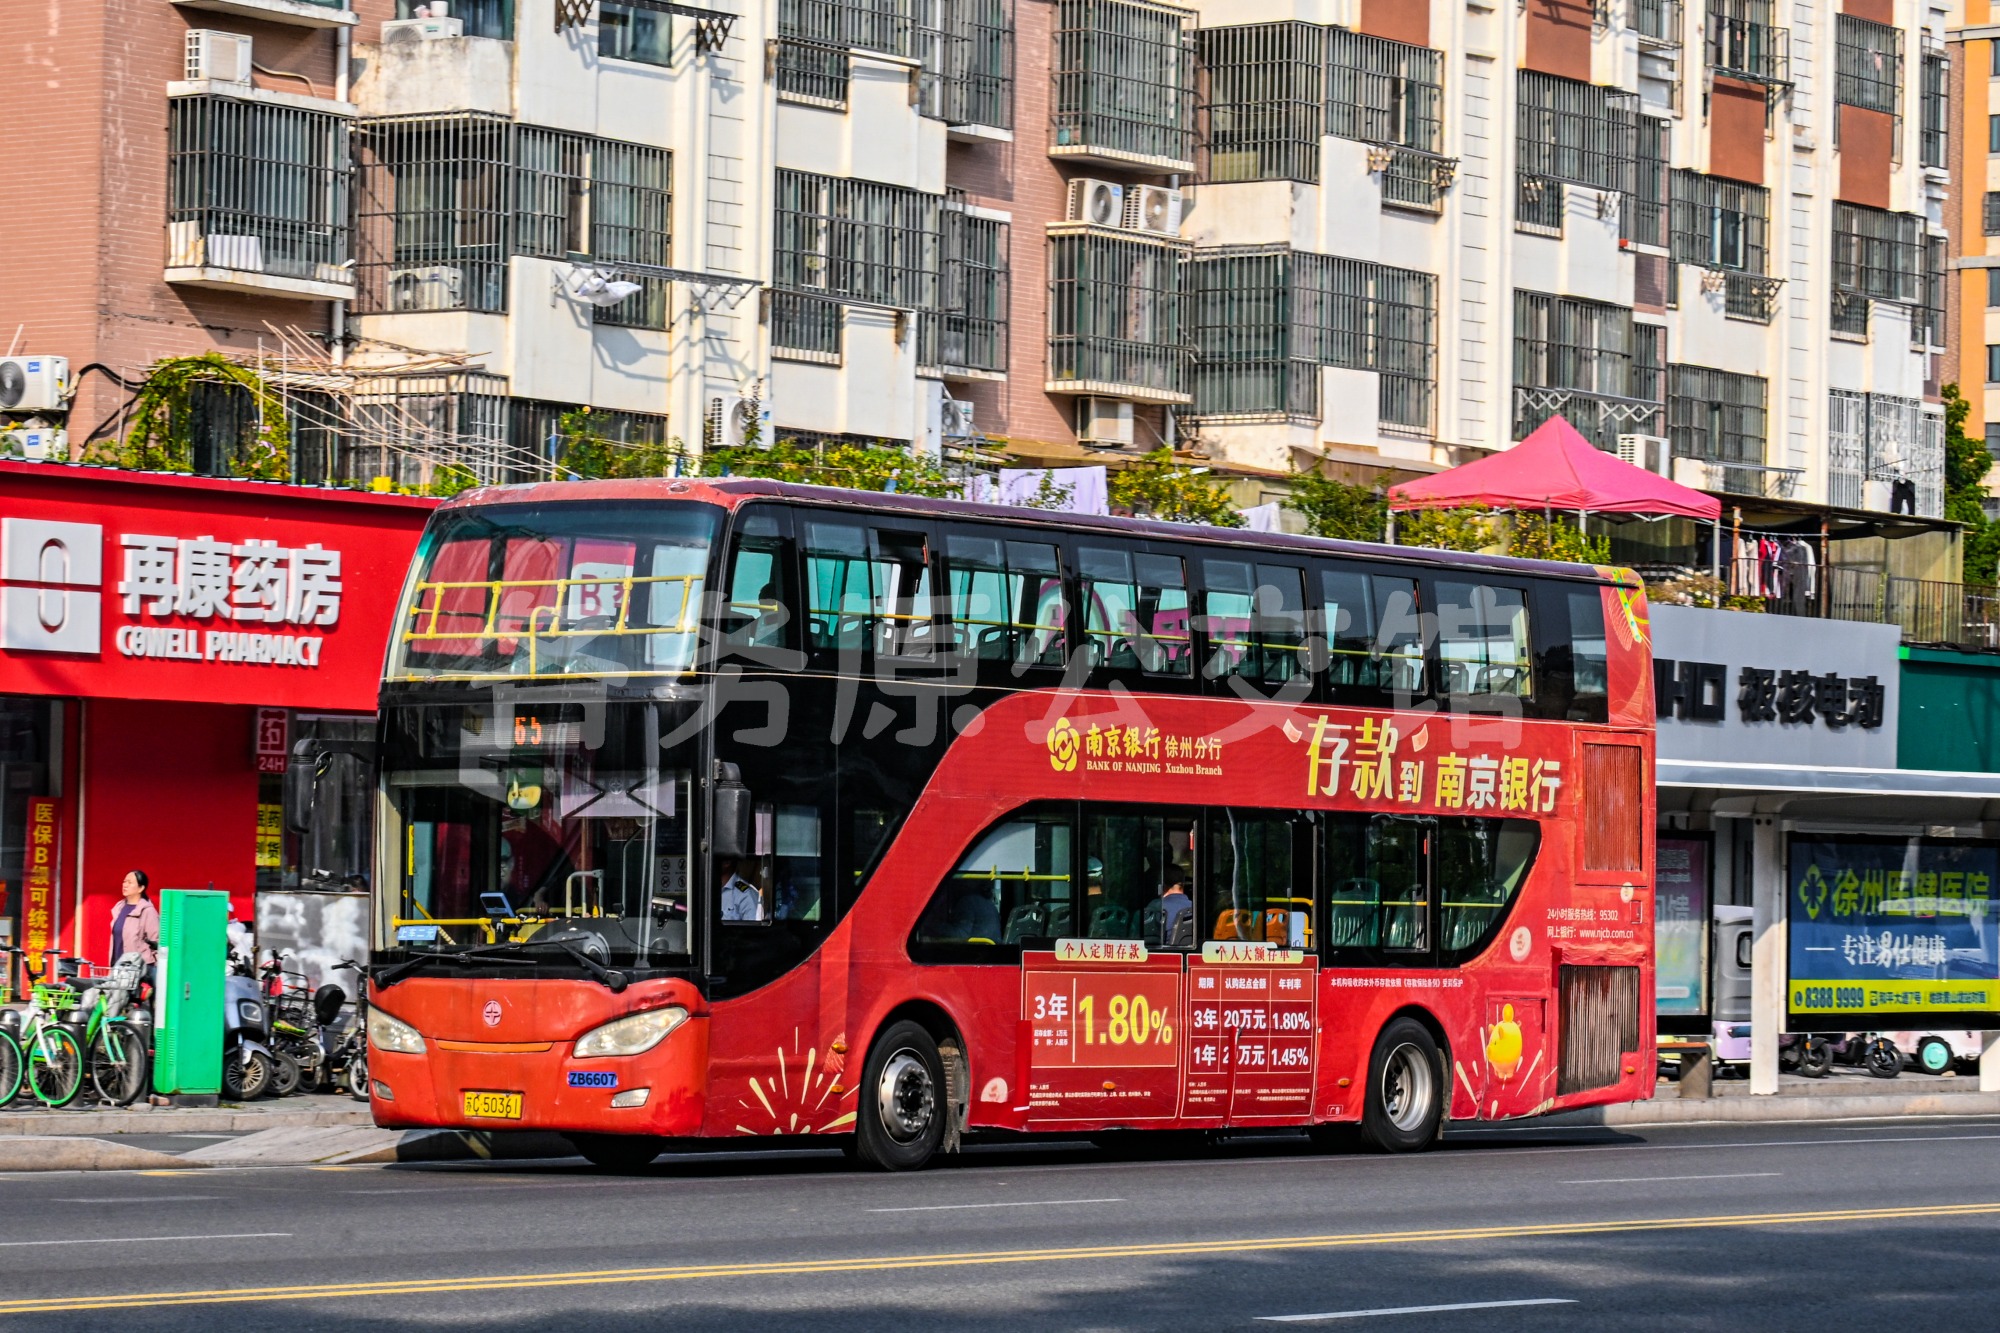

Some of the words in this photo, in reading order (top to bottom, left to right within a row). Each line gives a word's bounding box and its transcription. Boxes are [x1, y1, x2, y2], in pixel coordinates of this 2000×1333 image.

[117, 533, 343, 626] 再康药房
[116, 625, 203, 660] COWELL
[205, 630, 323, 667] PHARMACY
[1737, 666, 1885, 729] 极核电动
[1085, 722, 1162, 760] 南京银行
[1165, 735, 1223, 761] 徐州分行
[258, 755, 285, 772] 24H
[1086, 760, 1110, 772] BANK
[1112, 761, 1124, 772] OF
[1125, 762, 1161, 774] NANJING
[1165, 762, 1194, 775] Xuzhou
[1195, 764, 1223, 776] Branch
[1063, 942, 1141, 960] 个人定期存款
[1198, 977, 1214, 989] 期限
[1225, 977, 1267, 990] 认购起点金额
[1278, 978, 1302, 990] 年利率
[1033, 993, 1068, 1021] 3年
[1836, 987, 1864, 1008] 9999
[1079, 994, 1173, 1045] 1.80%
[1193, 1008, 1218, 1030] 3年
[1223, 1009, 1266, 1030] 20万元
[1272, 1011, 1310, 1030] 1.80%
[1193, 1044, 1217, 1066] 1年
[1222, 1045, 1265, 1065] 2万元
[1271, 1047, 1309, 1066] 1.45%
[569, 1072, 616, 1086] ZB6607
